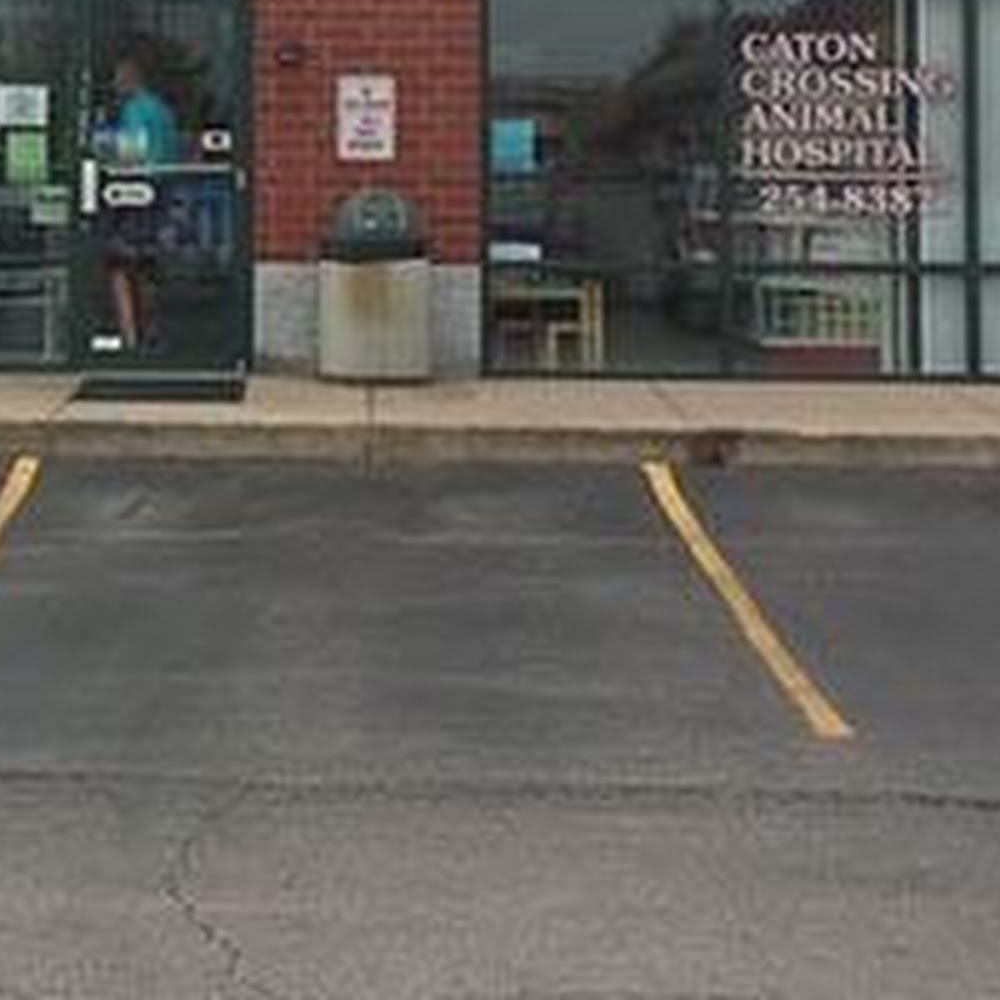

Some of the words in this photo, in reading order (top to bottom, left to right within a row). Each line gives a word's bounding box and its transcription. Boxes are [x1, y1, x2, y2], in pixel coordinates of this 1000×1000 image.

[741, 32, 876, 62] CATON
[741, 67, 954, 97] CROSSING
[743, 103, 903, 132] ANIMAL
